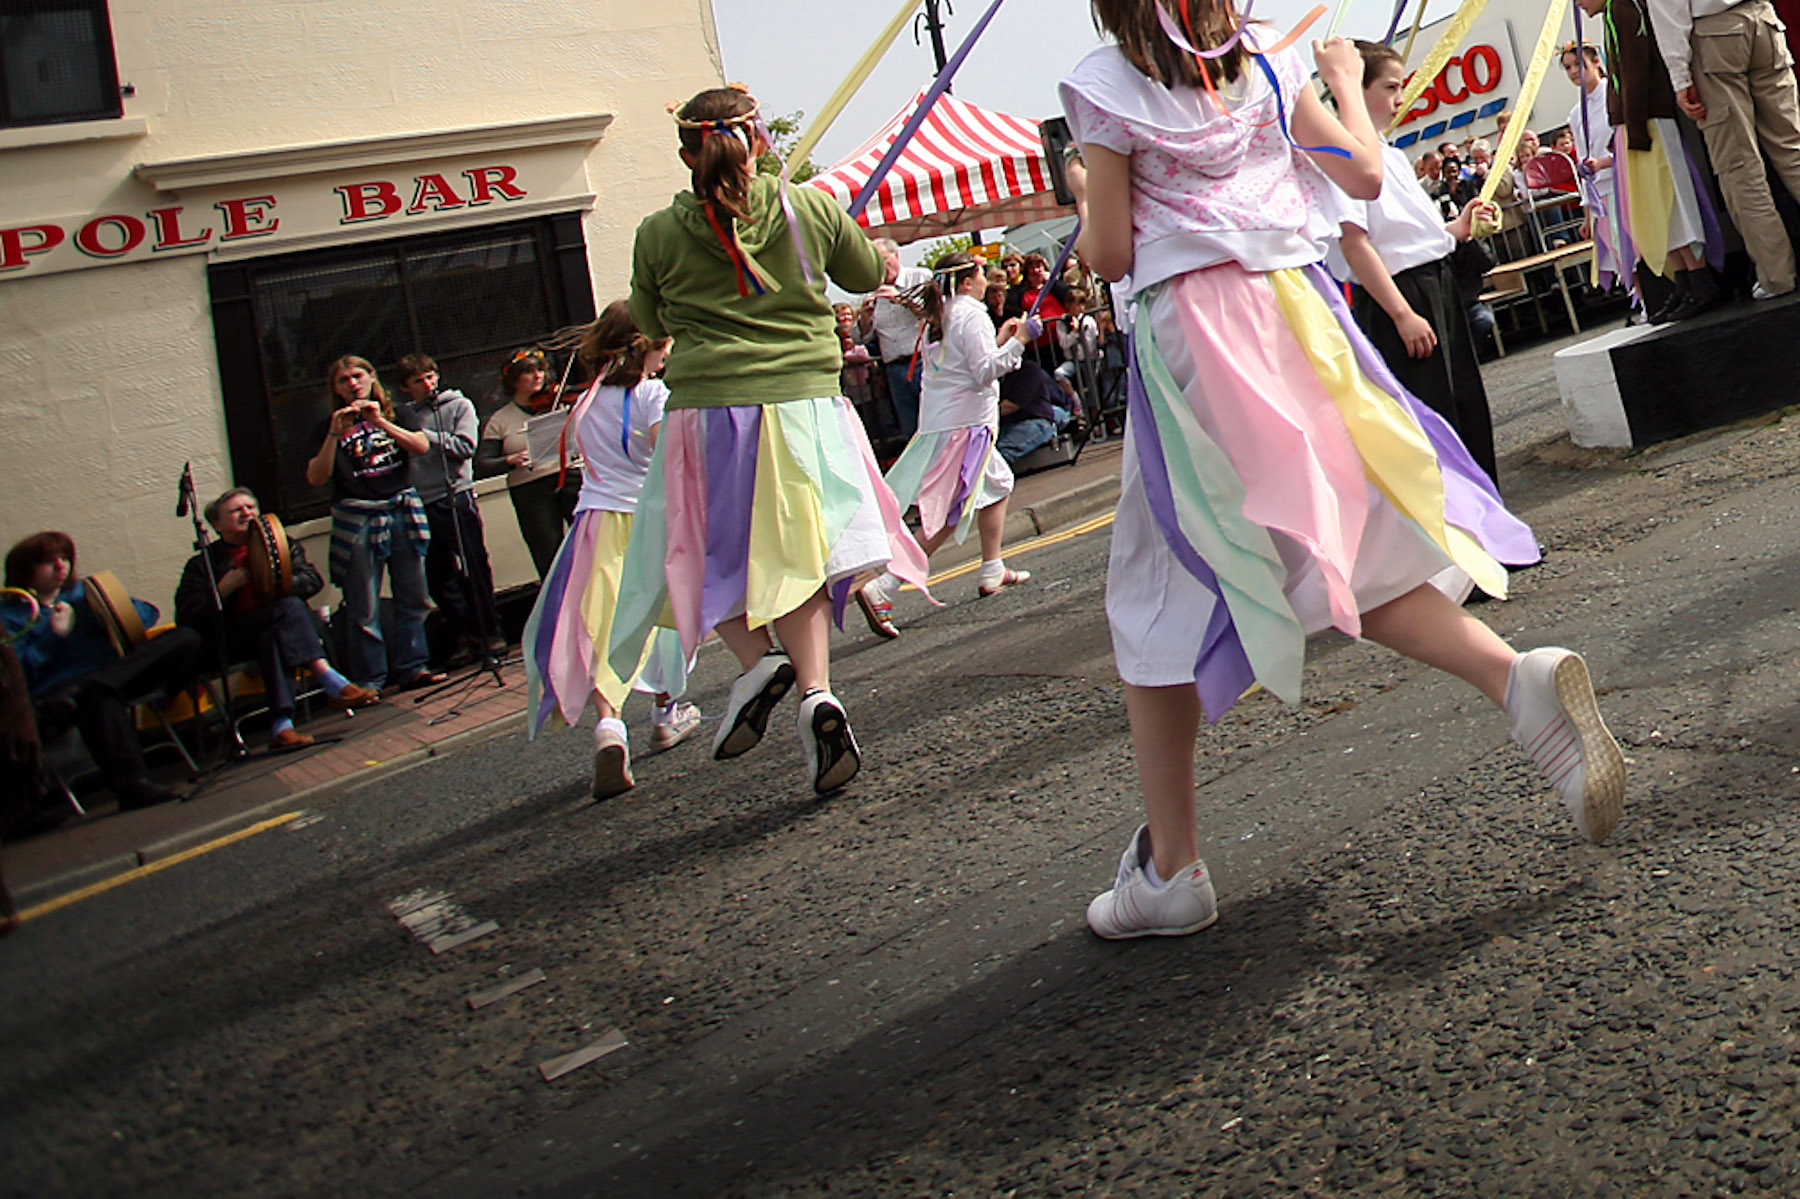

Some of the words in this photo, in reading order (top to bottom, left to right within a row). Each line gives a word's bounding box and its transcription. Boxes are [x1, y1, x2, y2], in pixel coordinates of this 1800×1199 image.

[1397, 44, 1502, 126] SCO
[0, 194, 281, 272] POLE
[333, 164, 528, 225] BAR
